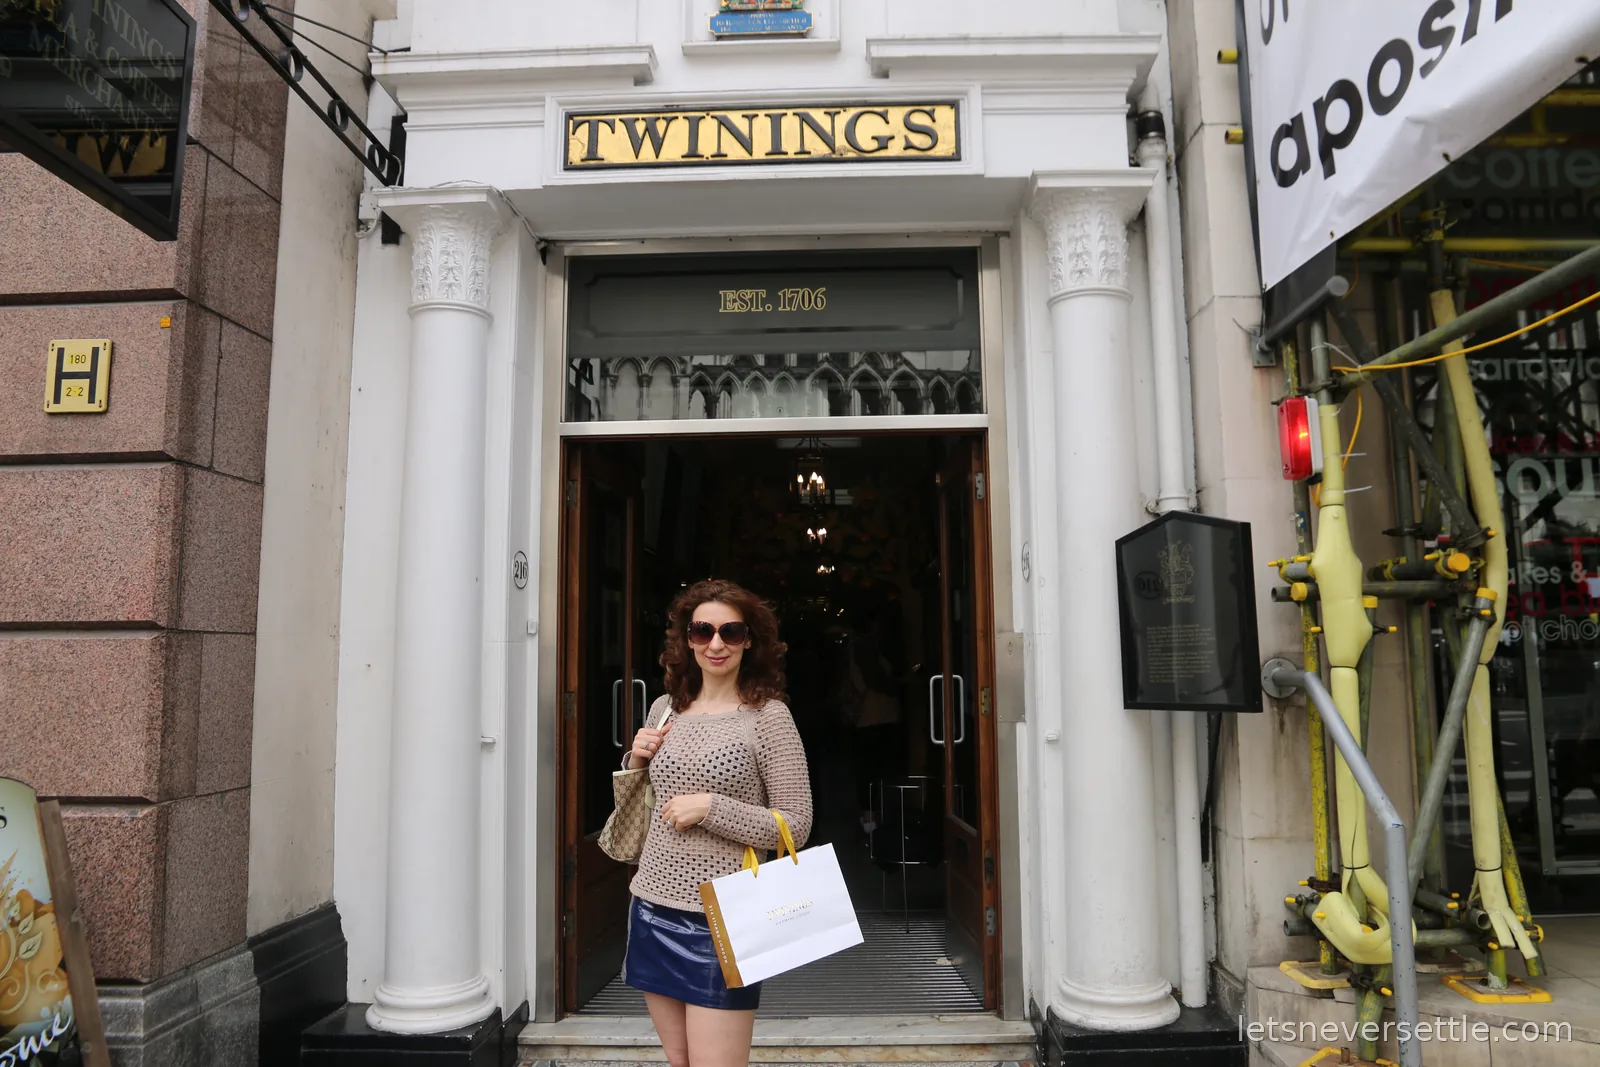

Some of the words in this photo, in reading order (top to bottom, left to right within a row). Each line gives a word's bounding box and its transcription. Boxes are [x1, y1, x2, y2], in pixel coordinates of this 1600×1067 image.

[29, 21, 164, 142] MERCHANTS
[85, 28, 99, 60] &
[106, 46, 174, 121] COFFEE
[572, 108, 939, 162] TWININGS
[719, 289, 773, 313] EST.
[778, 287, 827, 312] 1706
[53, 347, 99, 404] H
[70, 355, 86, 364] 180
[514, 560, 528, 579] 216
[1571, 560, 1587, 584] &
